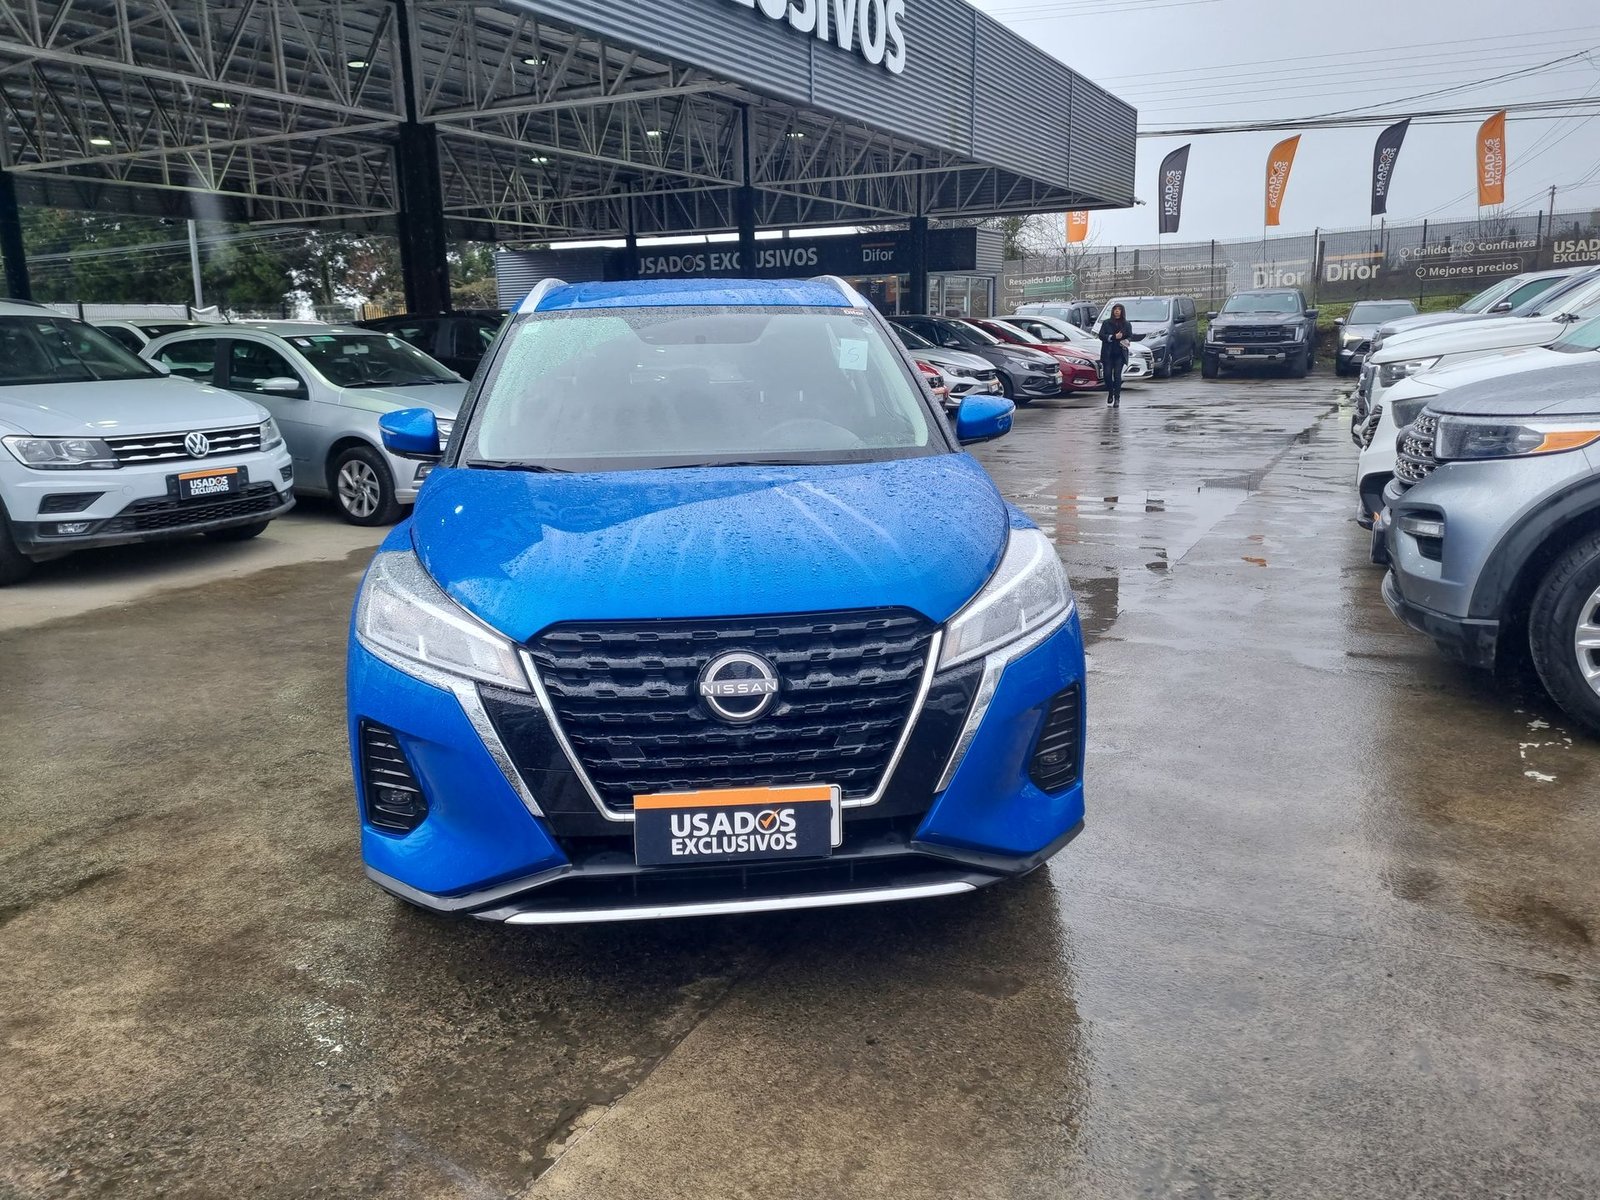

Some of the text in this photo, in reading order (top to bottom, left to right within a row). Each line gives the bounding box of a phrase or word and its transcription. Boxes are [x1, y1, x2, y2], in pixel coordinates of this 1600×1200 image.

[737, 0, 906, 74] IVOS
[1376, 147, 1391, 196] USADOS
[1484, 138, 1495, 187] USADOS
[1494, 137, 1503, 185] EXCLUSIVOS
[1165, 170, 1175, 216] USADOS
[1172, 170, 1182, 216] EXCLUSIVOS
[862, 248, 894, 262] Difor
[1413, 238, 1536, 257] Calidad Confianza
[710, 247, 818, 270] EXCUSIVOS
[1009, 274, 1065, 286] Respaldo Difor
[1253, 270, 1305, 288] Difor
[1326, 262, 1380, 282] Difor
[1429, 261, 1519, 278] Mejores precios
[189, 476, 229, 489] USADOS
[190, 484, 230, 496] EXCLUSIVOS
[702, 680, 777, 695] NISSAN
[671, 808, 796, 837] USADOS
[671, 832, 797, 856] EXCLUSIVOS
